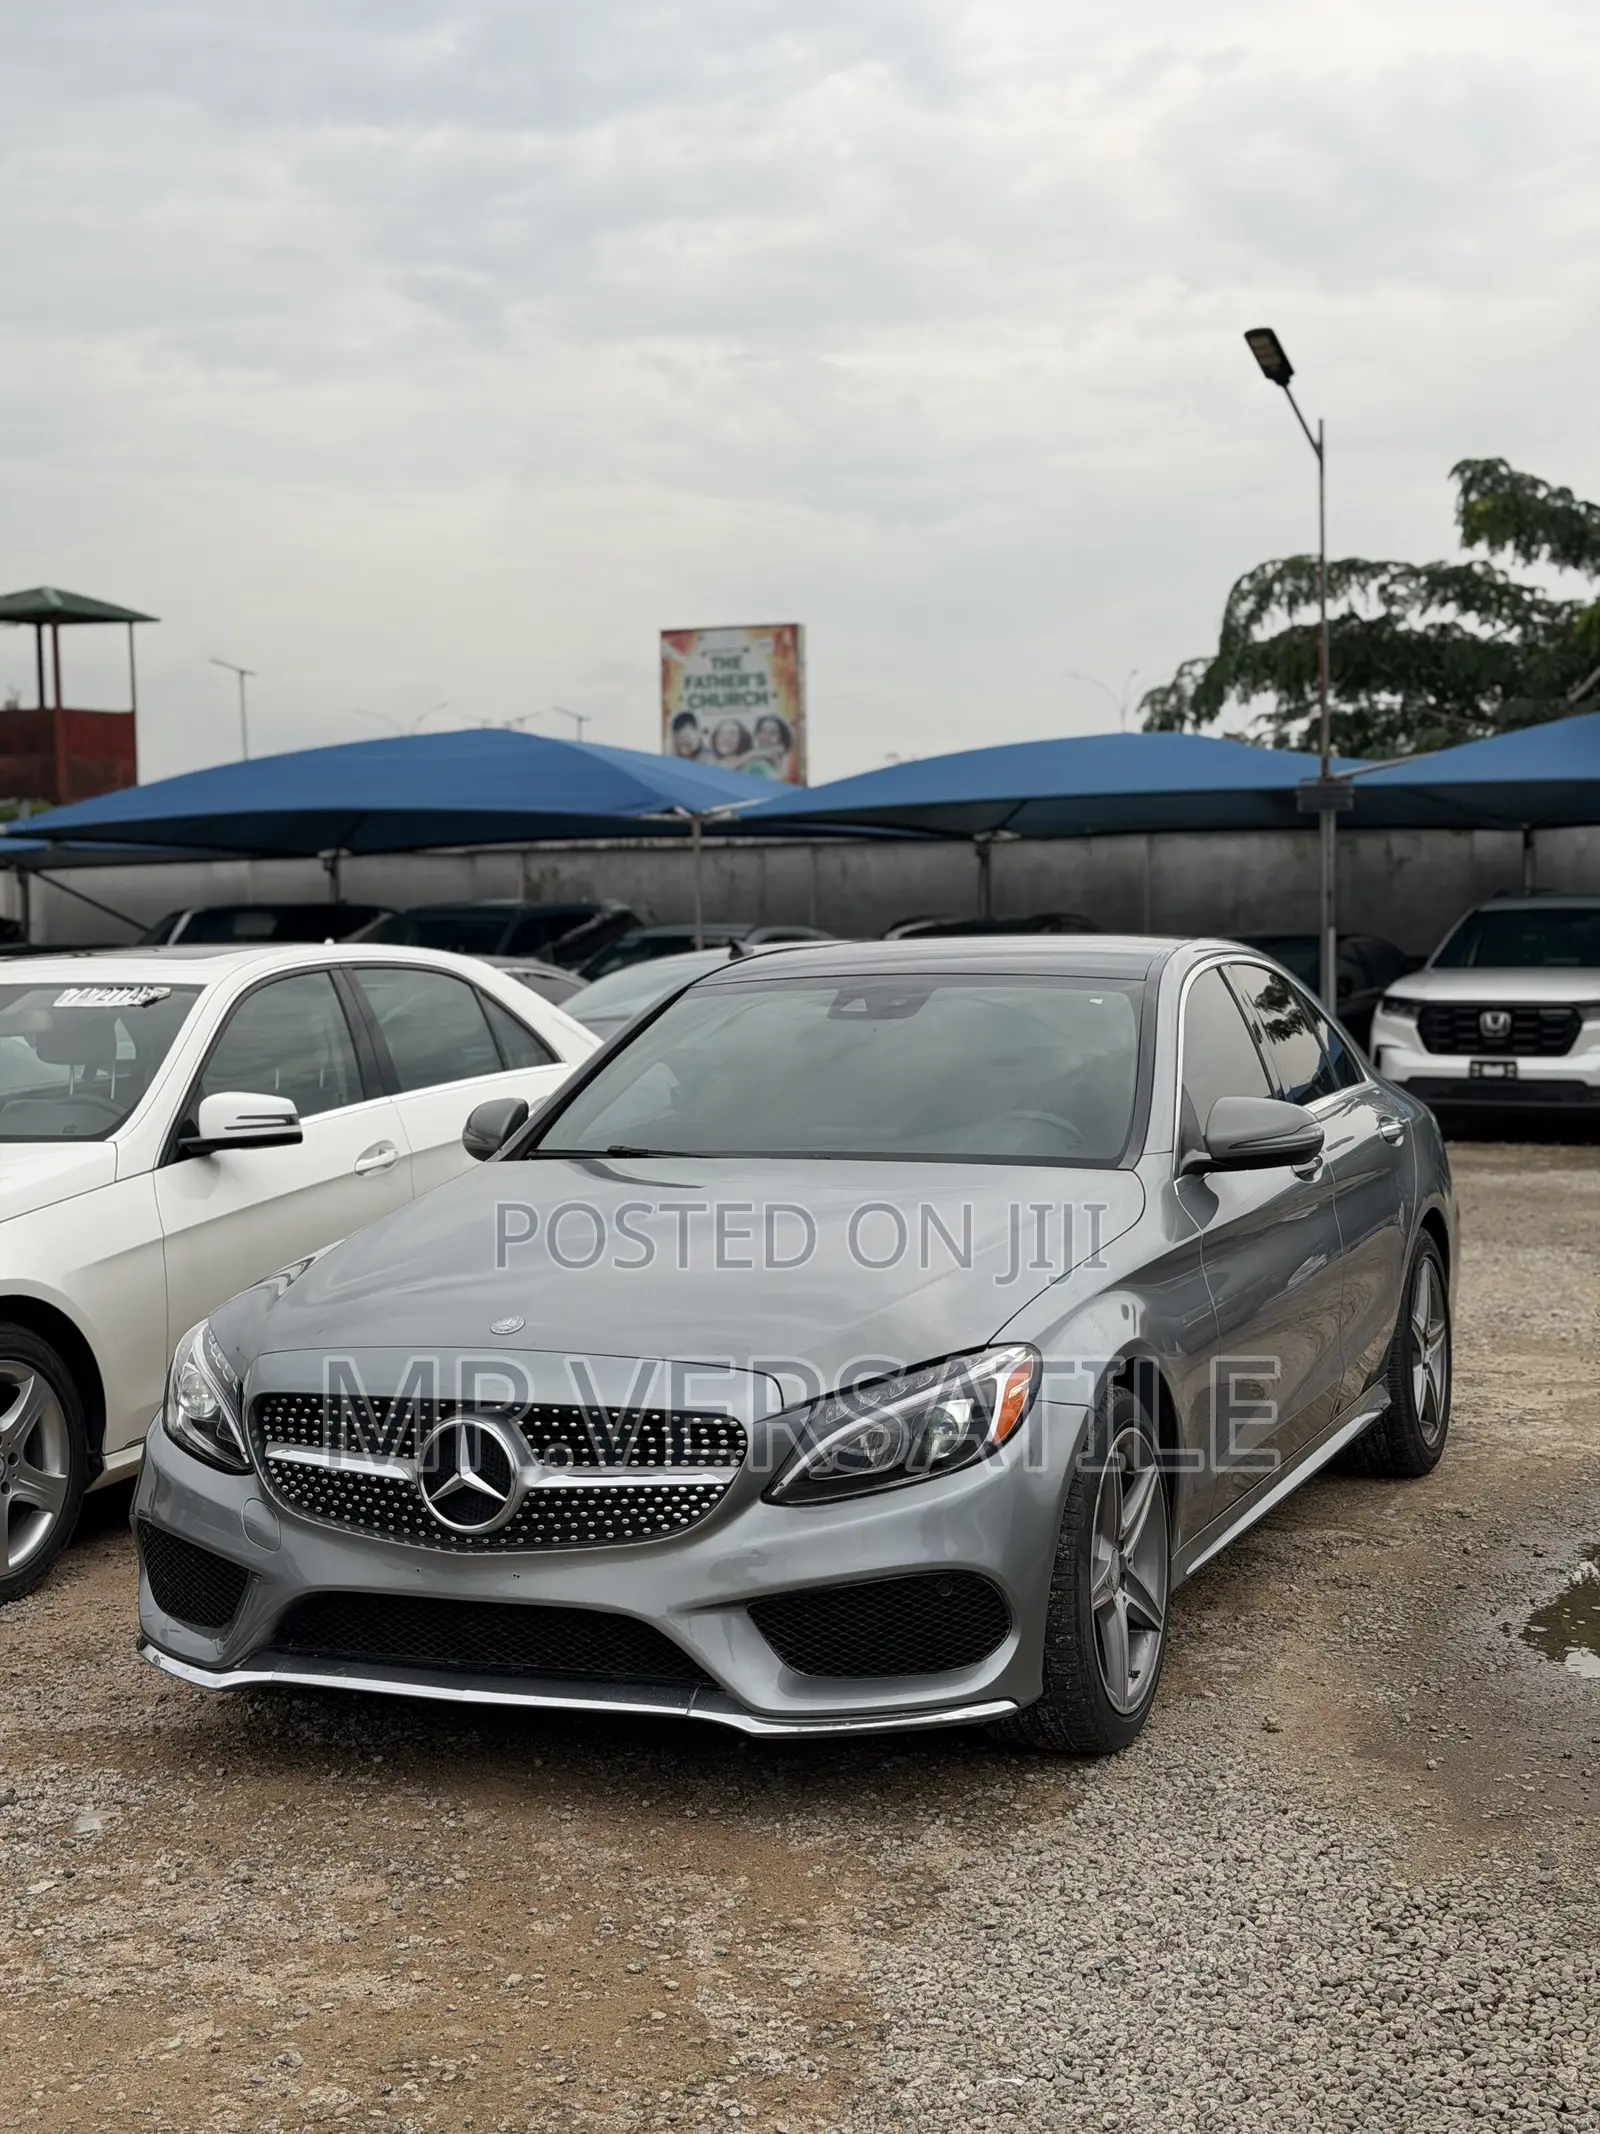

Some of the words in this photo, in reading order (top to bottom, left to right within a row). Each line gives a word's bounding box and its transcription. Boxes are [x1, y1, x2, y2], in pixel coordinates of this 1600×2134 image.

[710, 655, 742, 670] THE
[684, 672, 767, 690] FATHER'S
[687, 691, 769, 709] CHURCH
